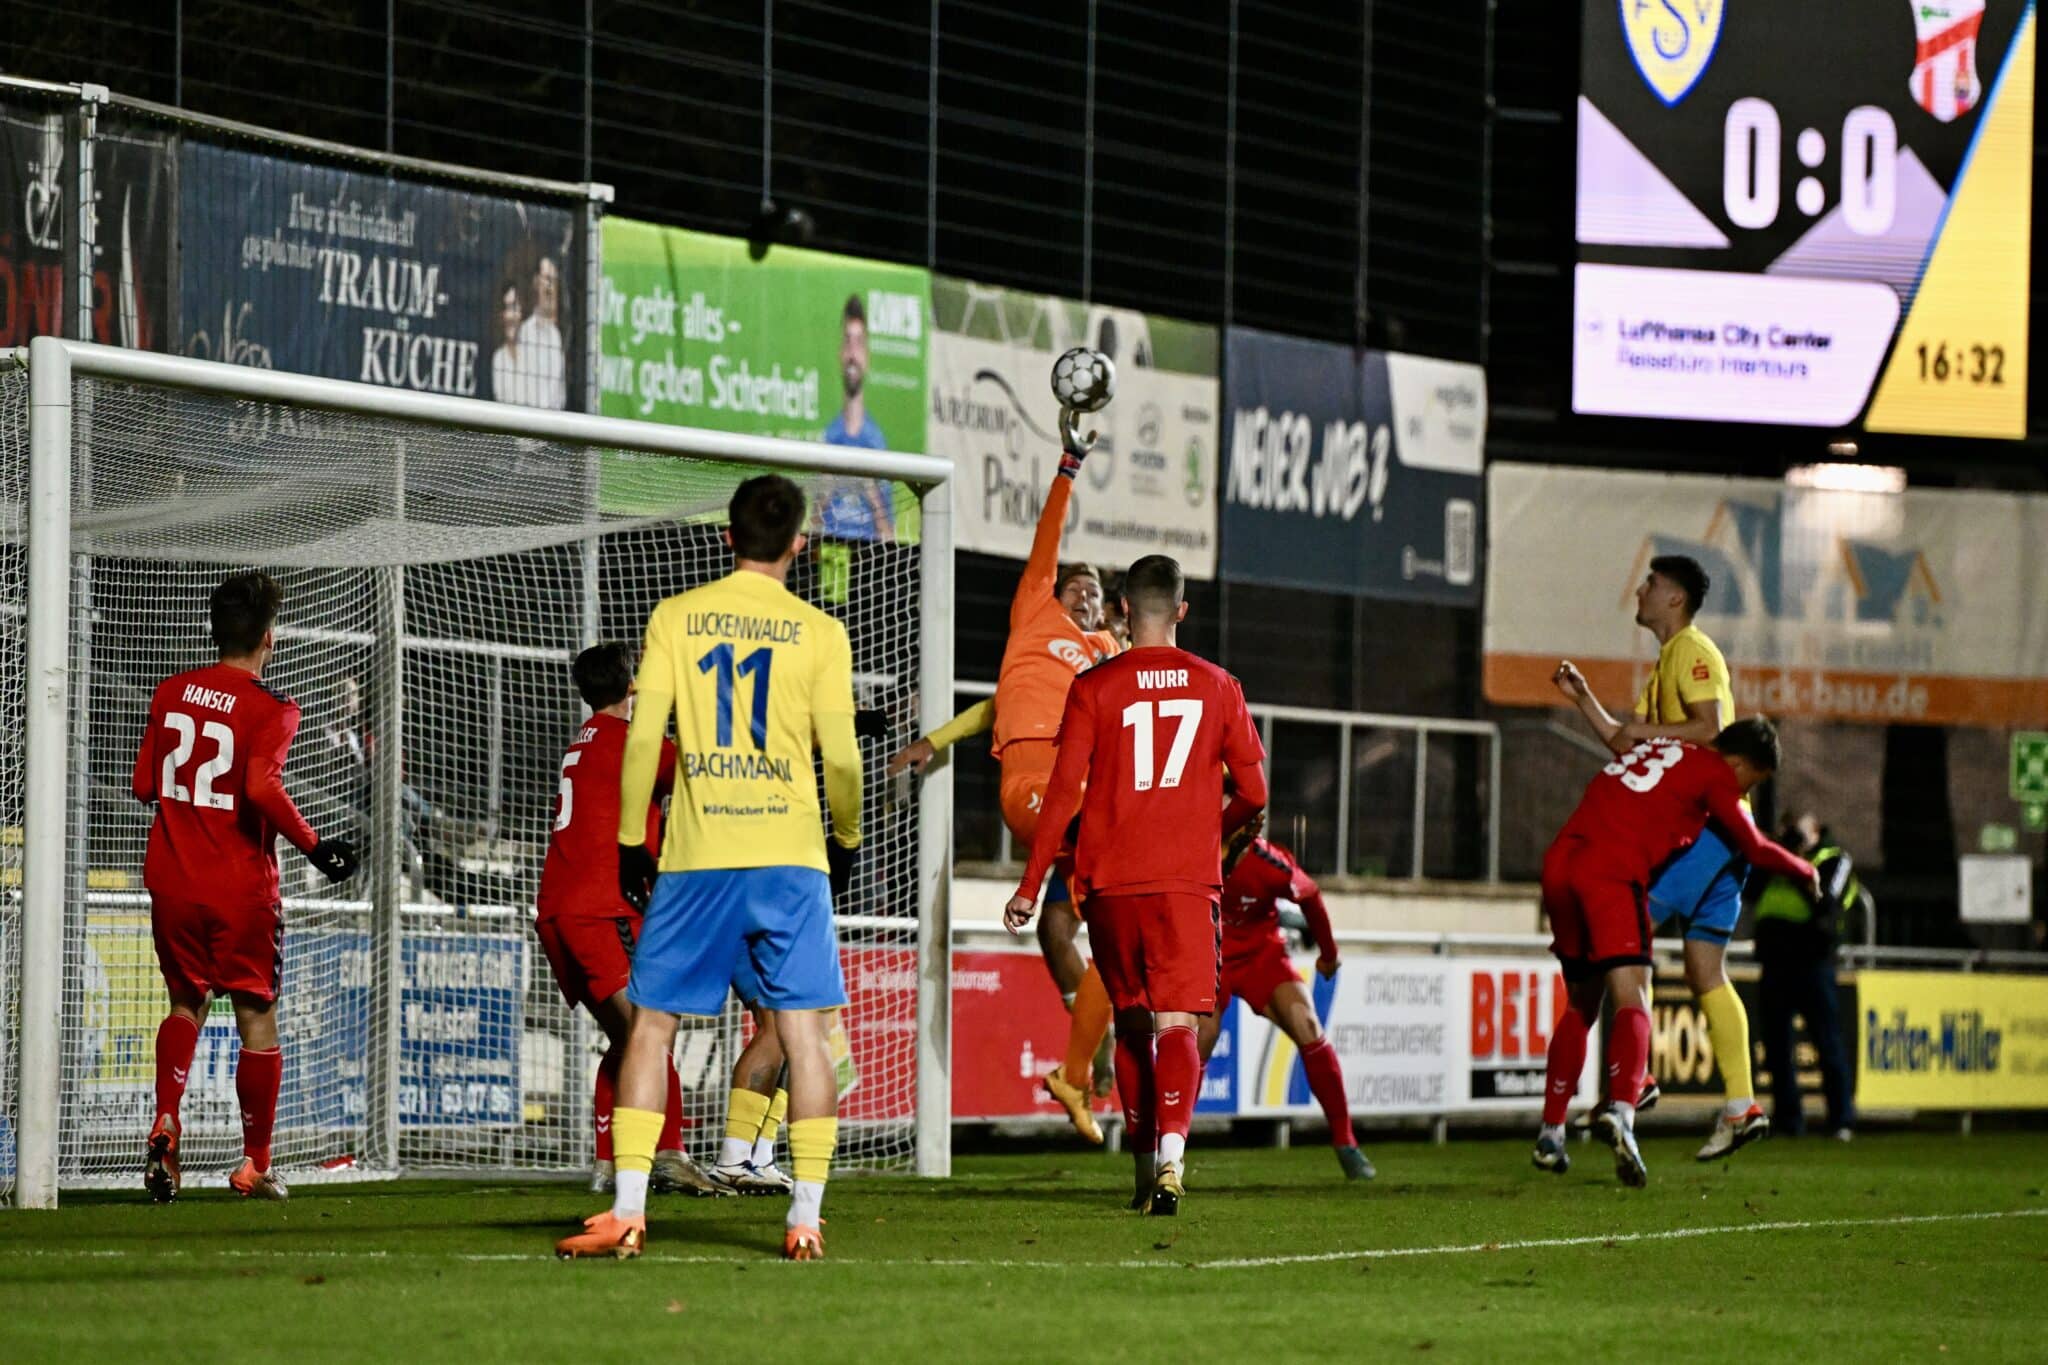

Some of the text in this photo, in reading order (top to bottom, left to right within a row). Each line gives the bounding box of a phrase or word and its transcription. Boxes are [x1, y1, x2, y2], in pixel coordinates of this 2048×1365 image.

[1724, 97, 1897, 236] 0:0
[317, 248, 449, 319] TRAUM-
[360, 317, 478, 396] KÜCHE
[1618, 319, 1831, 348] Lufthansa City Center
[1917, 344, 2005, 383] 16:32
[983, 453, 1080, 549] Prokp
[687, 611, 801, 645] LUCKENWALDE
[182, 683, 237, 714] HANSCH
[697, 642, 774, 752] 11
[1136, 669, 1190, 689] WURR
[162, 712, 234, 811] 22
[684, 752, 793, 783] BACHMANN
[1122, 699, 1204, 791] 17
[703, 804, 789, 816] Märkischer Hof
[1867, 1009, 2003, 1073] Reifen-Müller
